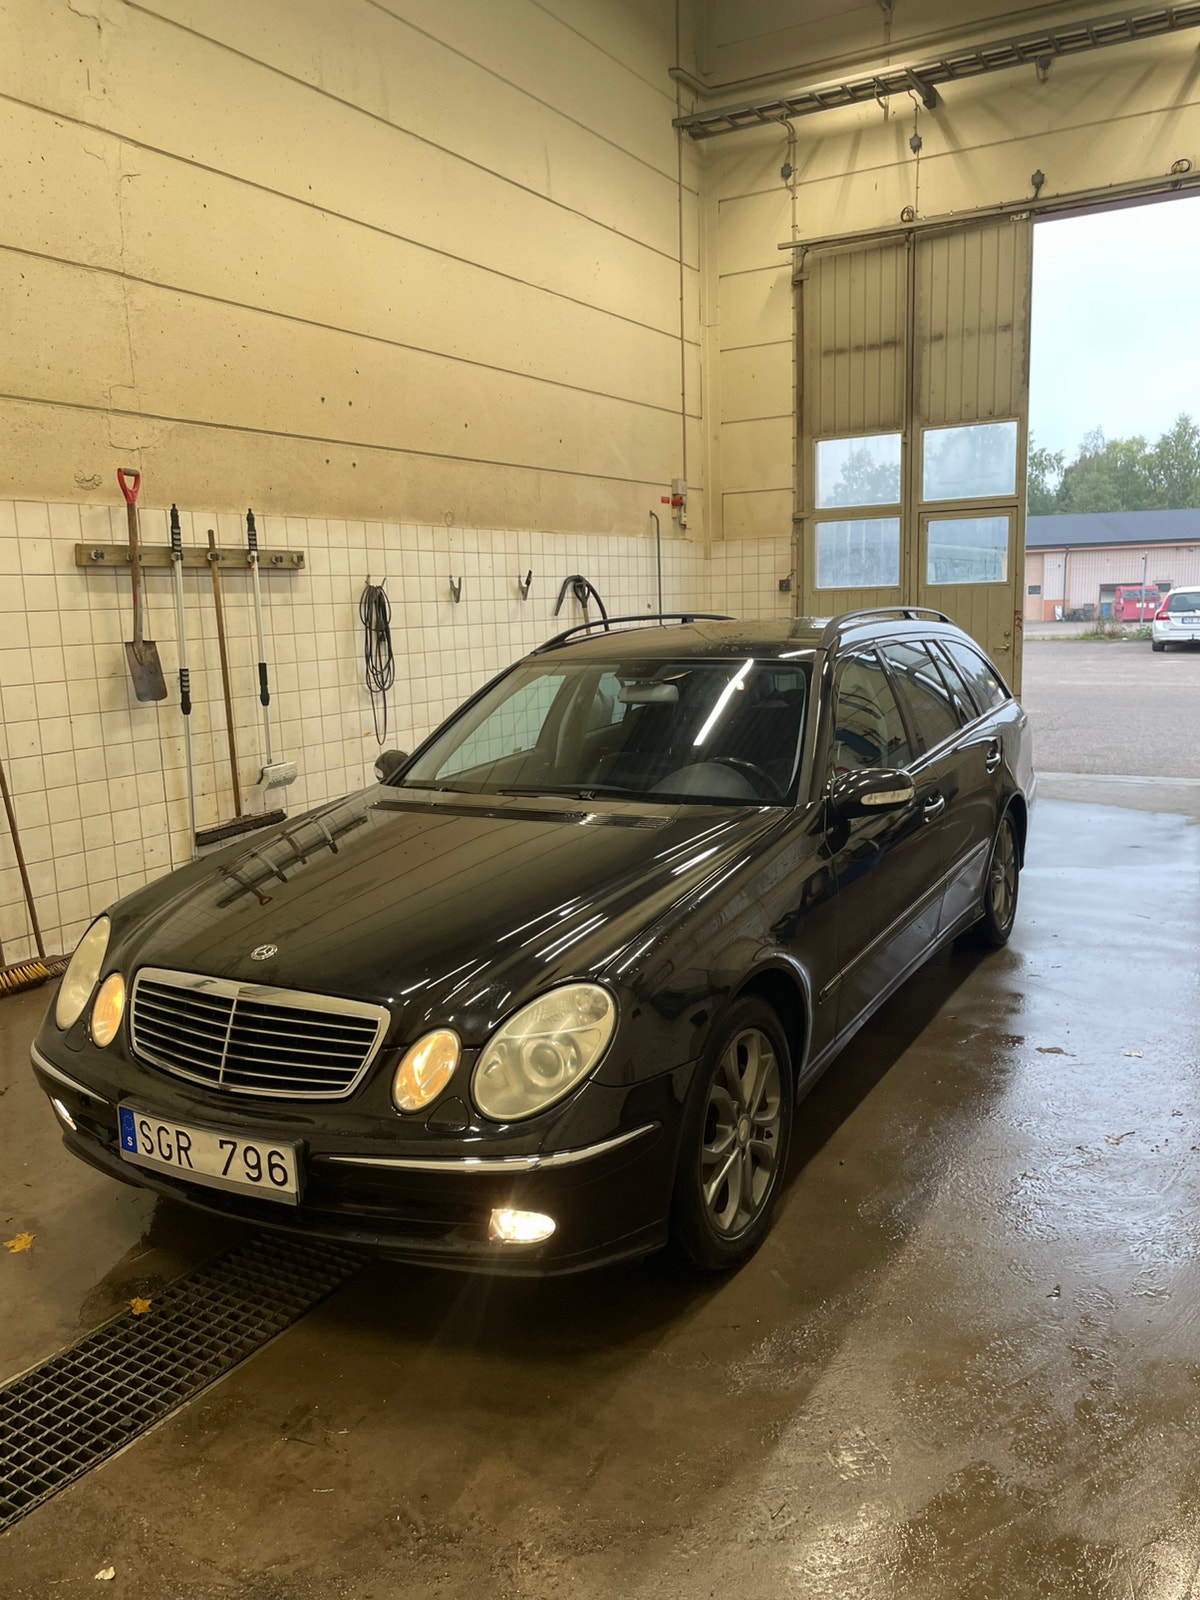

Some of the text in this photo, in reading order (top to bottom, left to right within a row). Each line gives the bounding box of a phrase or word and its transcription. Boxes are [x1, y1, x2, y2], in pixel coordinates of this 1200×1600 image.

[127, 1136, 133, 1147] S
[139, 1120, 288, 1186] SGR 796
